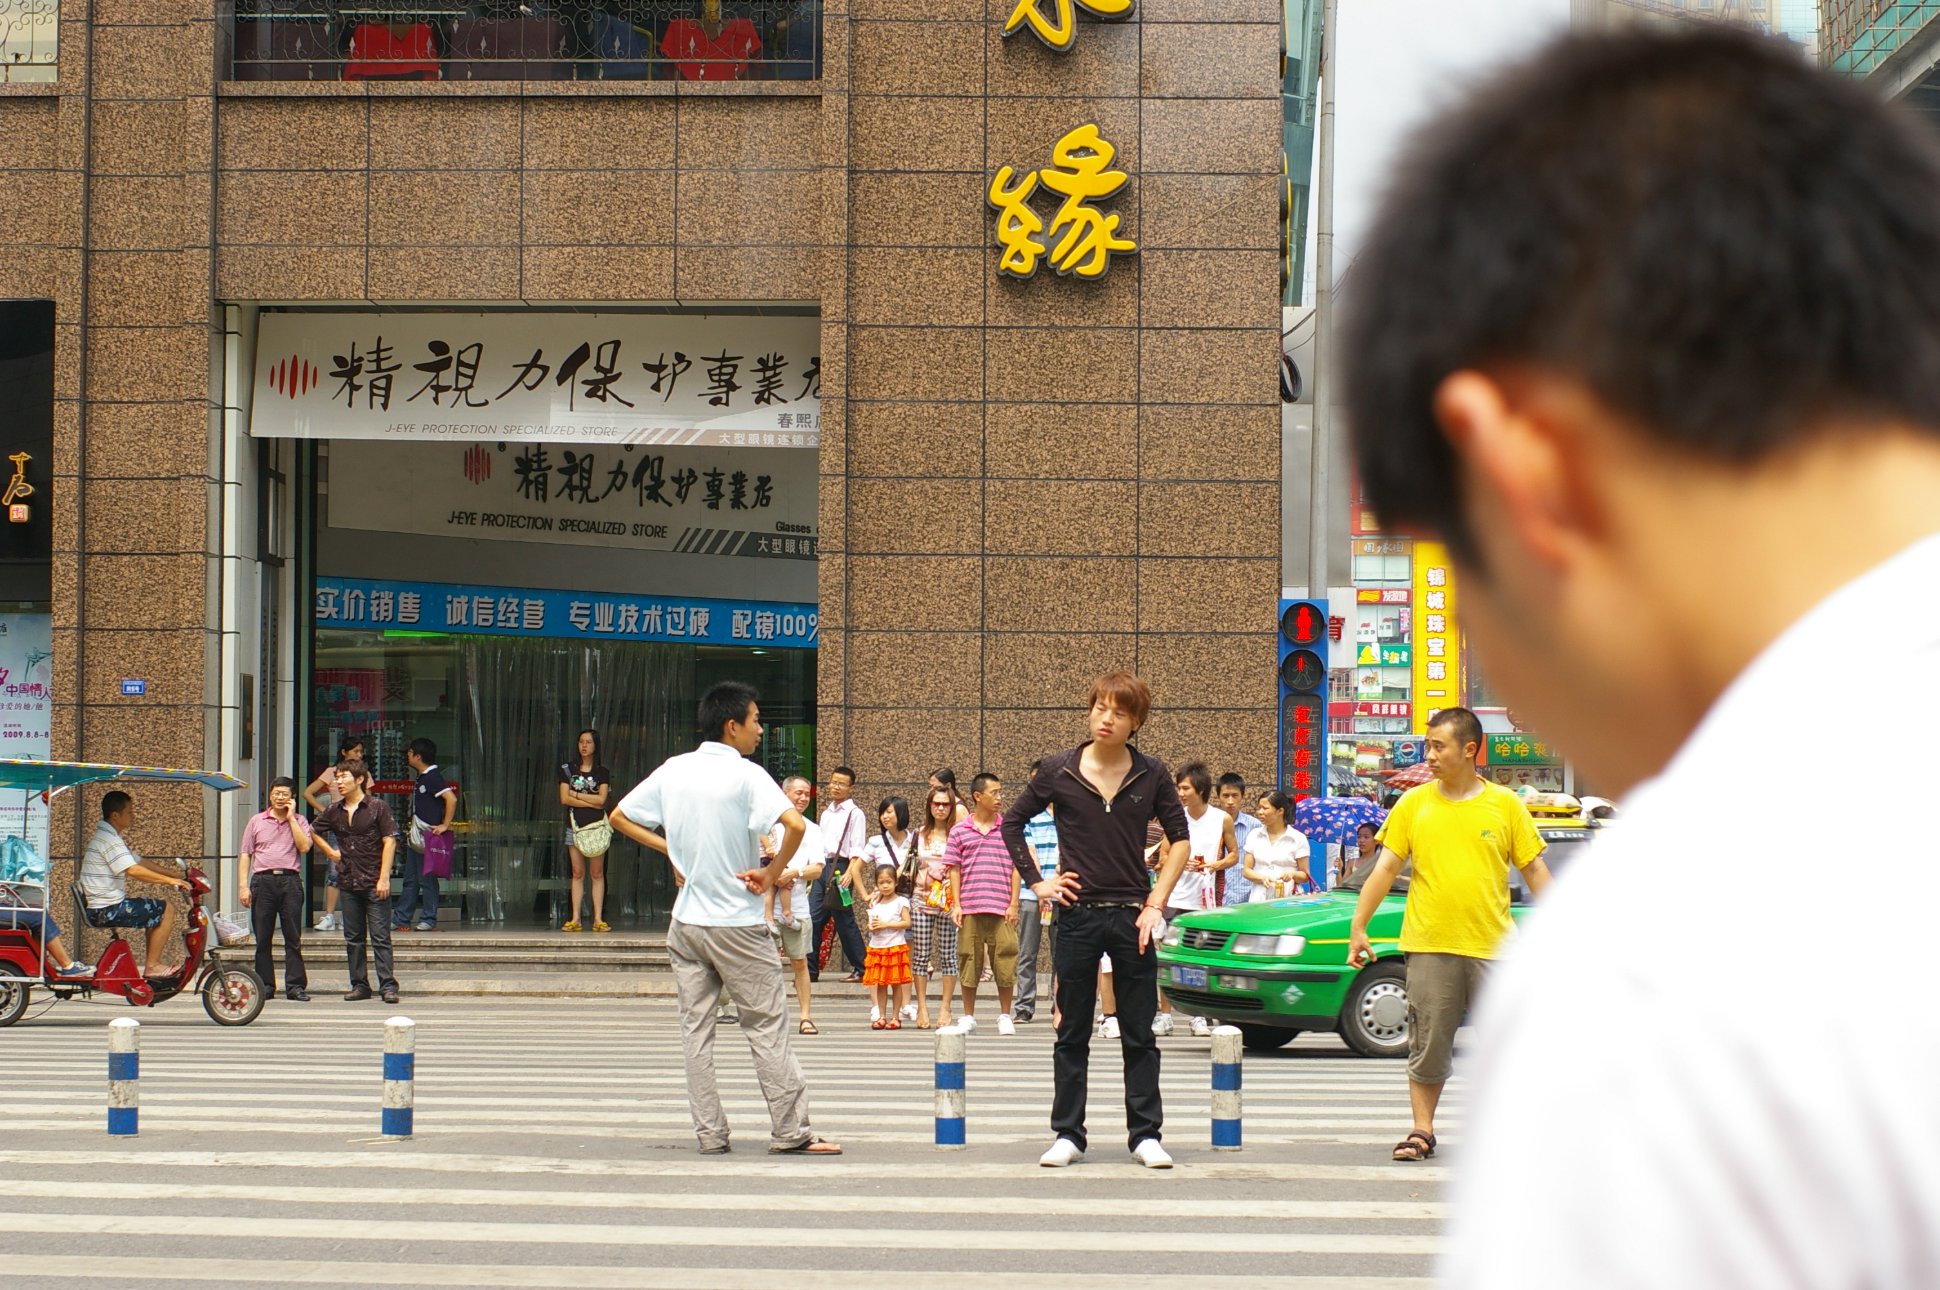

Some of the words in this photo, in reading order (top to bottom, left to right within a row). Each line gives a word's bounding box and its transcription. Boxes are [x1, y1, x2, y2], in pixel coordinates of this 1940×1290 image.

[385, 423, 416, 434] J-EYE
[422, 424, 498, 435] PROTECTION
[502, 425, 576, 437] SPECIALIZED
[581, 426, 618, 437] STORE
[447, 510, 477, 526] J-EYE
[481, 512, 553, 531] PROTECTION
[558, 517, 627, 536] SPECIALIZED
[631, 523, 669, 539] STORE
[776, 520, 811, 534] Glasses
[316, 586, 422, 624] 实价销售
[446, 594, 546, 630] 诚信经营
[569, 600, 710, 637] 专业技术过硬
